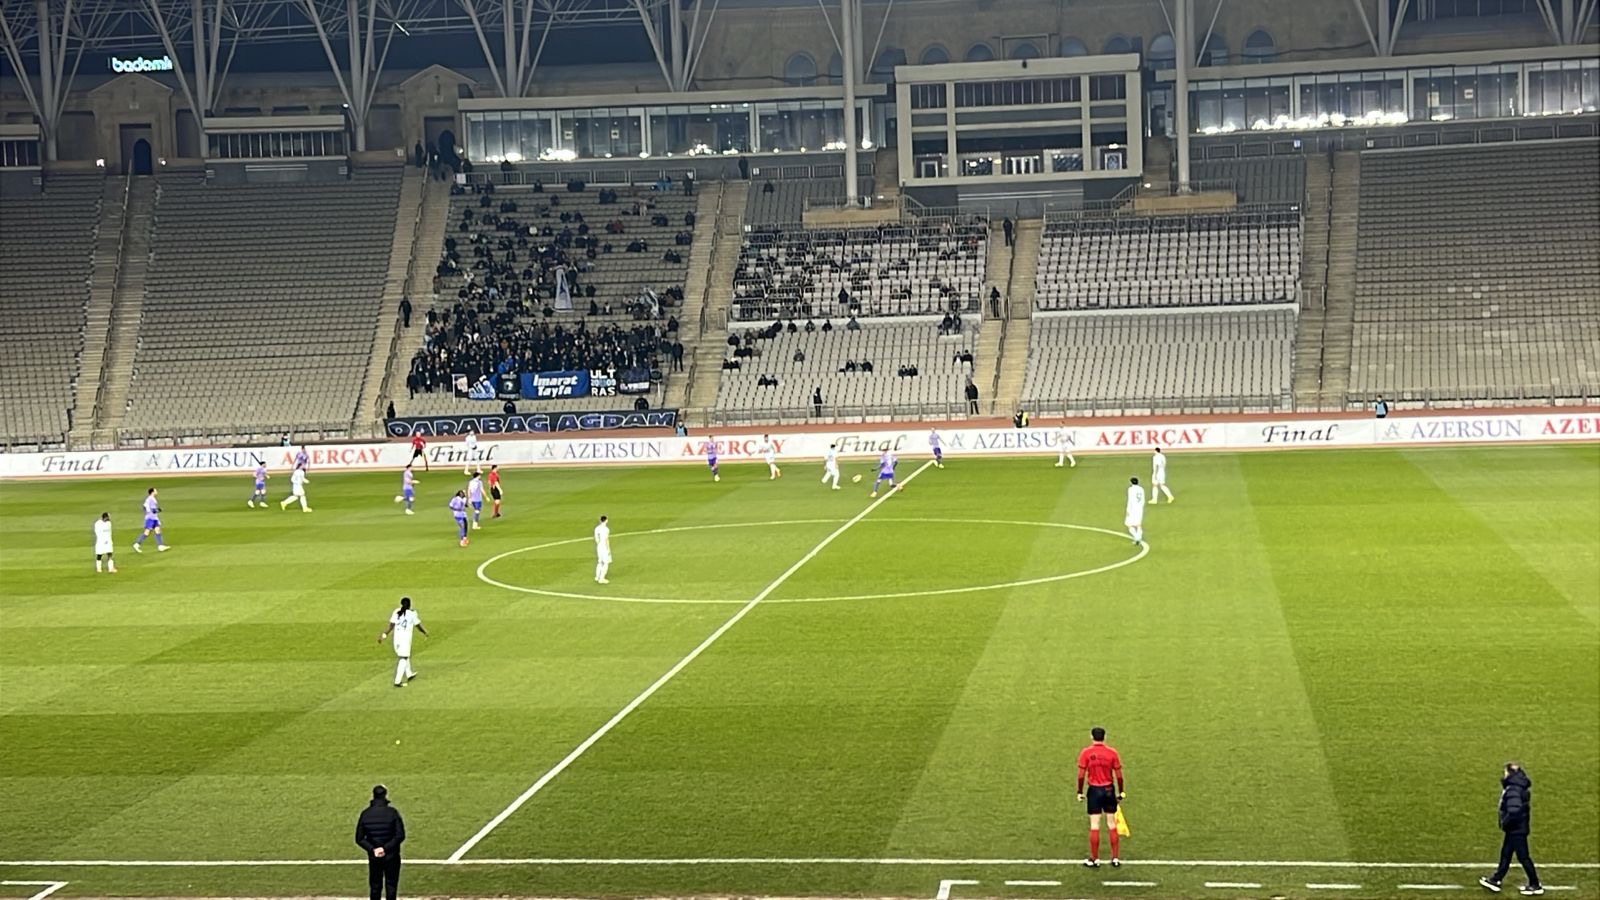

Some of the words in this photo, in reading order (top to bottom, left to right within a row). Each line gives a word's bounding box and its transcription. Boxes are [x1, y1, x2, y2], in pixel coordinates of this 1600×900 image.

[538, 386, 572, 398] Tayfa
[591, 387, 616, 397] RAS
[1096, 428, 1208, 447] AZERÇAY
[1262, 423, 1339, 443] Final
[1411, 419, 1522, 439] AZERSUN
[563, 441, 662, 460] AZERSUN
[681, 439, 786, 457] AZERÇY
[835, 434, 907, 453] Final
[42, 454, 109, 473] Final
[168, 451, 263, 469] AZERSUN
[281, 448, 383, 466] AERÇAY
